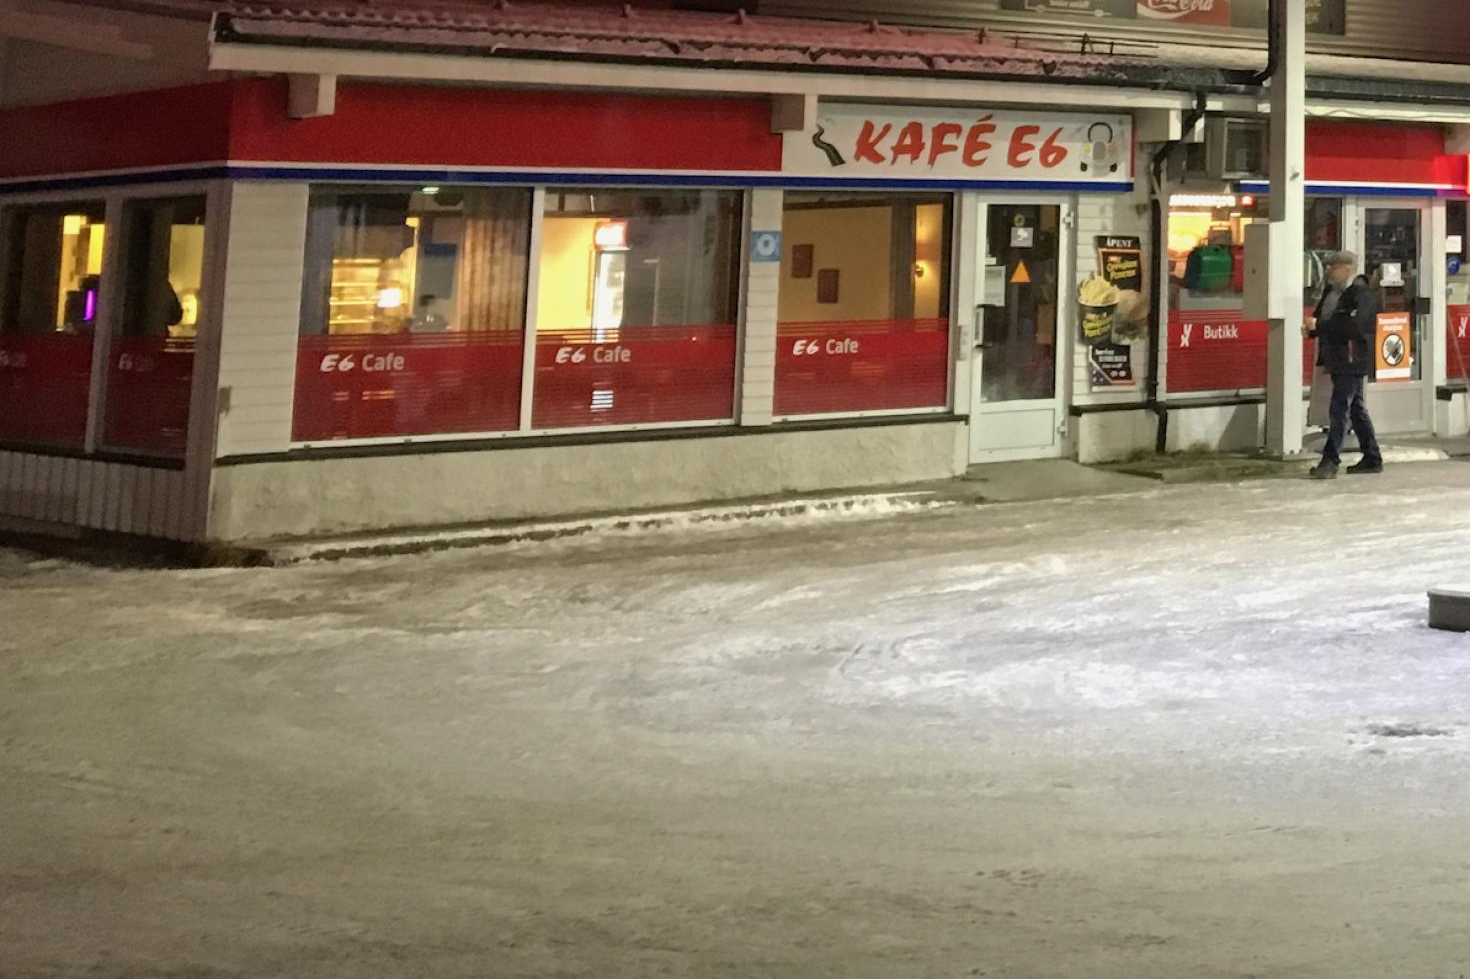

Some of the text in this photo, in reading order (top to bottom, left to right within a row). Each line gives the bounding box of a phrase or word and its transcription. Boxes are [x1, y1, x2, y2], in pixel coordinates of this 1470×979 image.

[854, 114, 1068, 169] KAFÉ E6
[1203, 324, 1238, 340] Butikk
[555, 346, 631, 363] E6 Cafe
[793, 338, 859, 356] E6 Cafe
[320, 352, 405, 372] E6 Cafe
